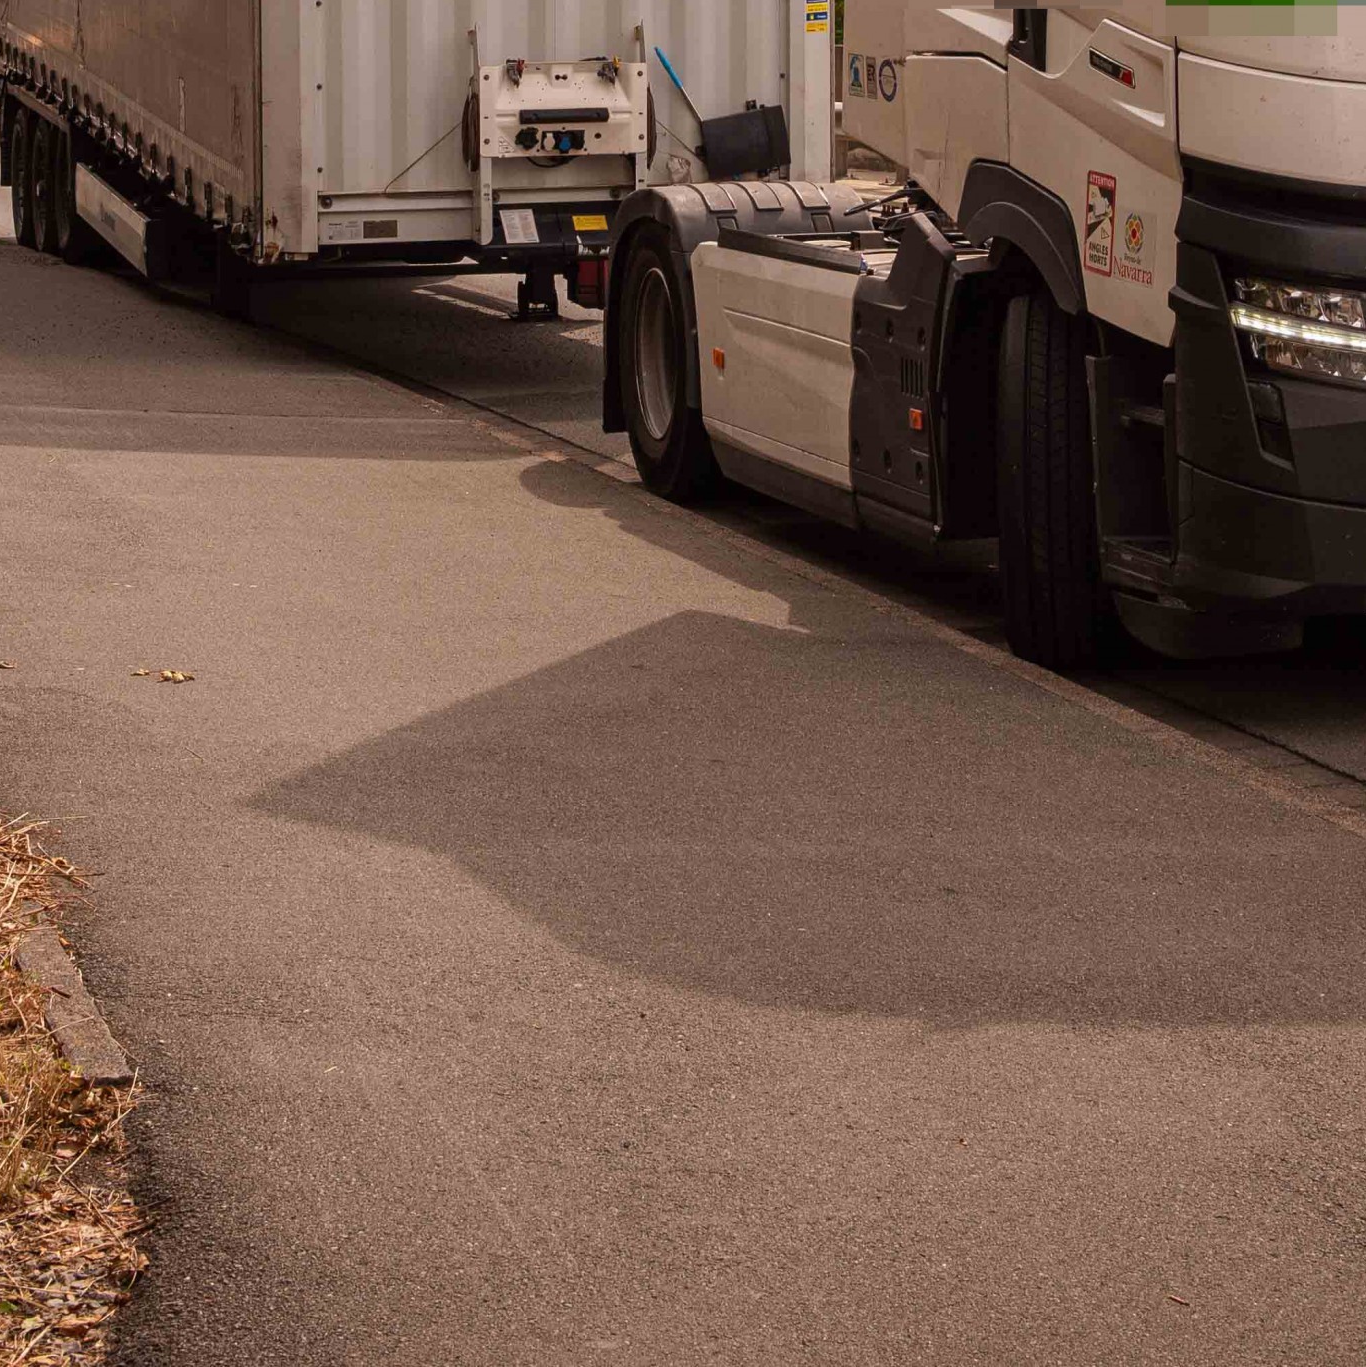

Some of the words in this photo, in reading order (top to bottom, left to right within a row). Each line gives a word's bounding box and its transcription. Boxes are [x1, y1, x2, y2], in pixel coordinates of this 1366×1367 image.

[1090, 174, 1115, 188] ATTENTION
[1089, 241, 1108, 256] ANGLES
[1088, 253, 1108, 267] MORTS
[1114, 255, 1153, 286] Navarra
